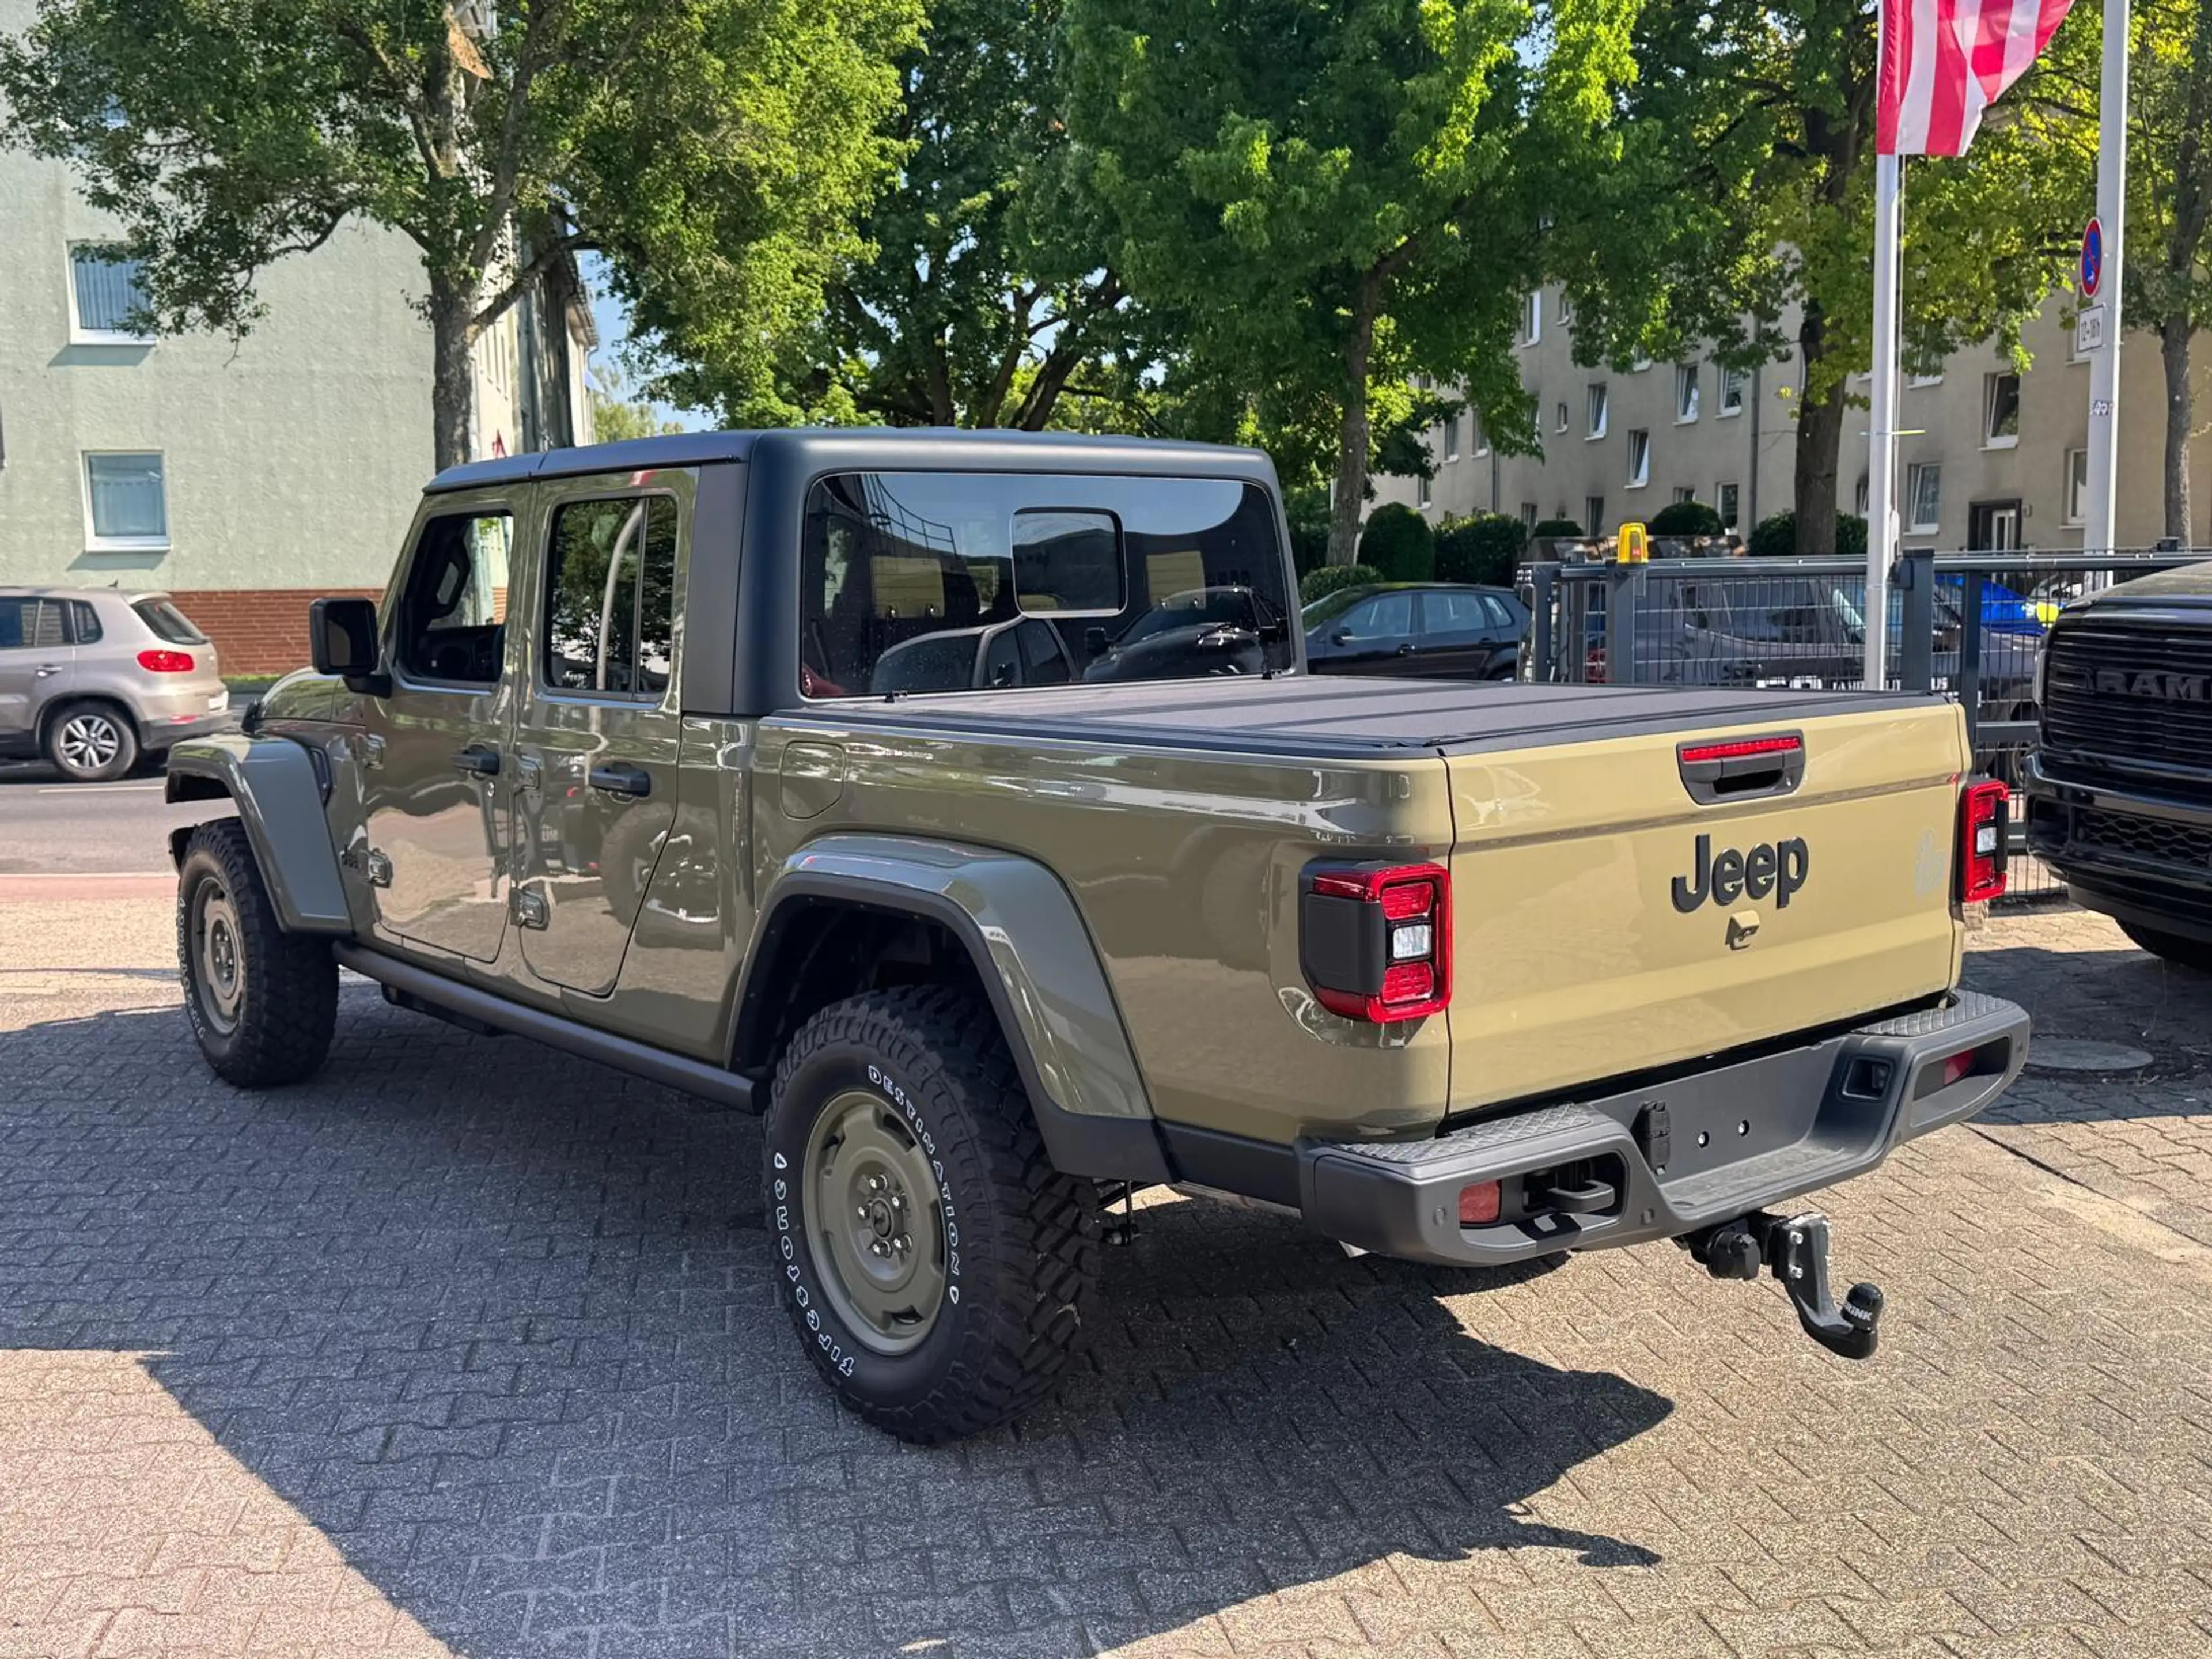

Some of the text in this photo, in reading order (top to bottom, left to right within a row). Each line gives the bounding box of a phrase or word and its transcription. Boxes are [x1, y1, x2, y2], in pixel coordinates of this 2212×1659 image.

[2096, 671, 2203, 701] RAM
[1671, 834, 1809, 914] Jeep
[868, 1064, 960, 1276] DESTINATION
